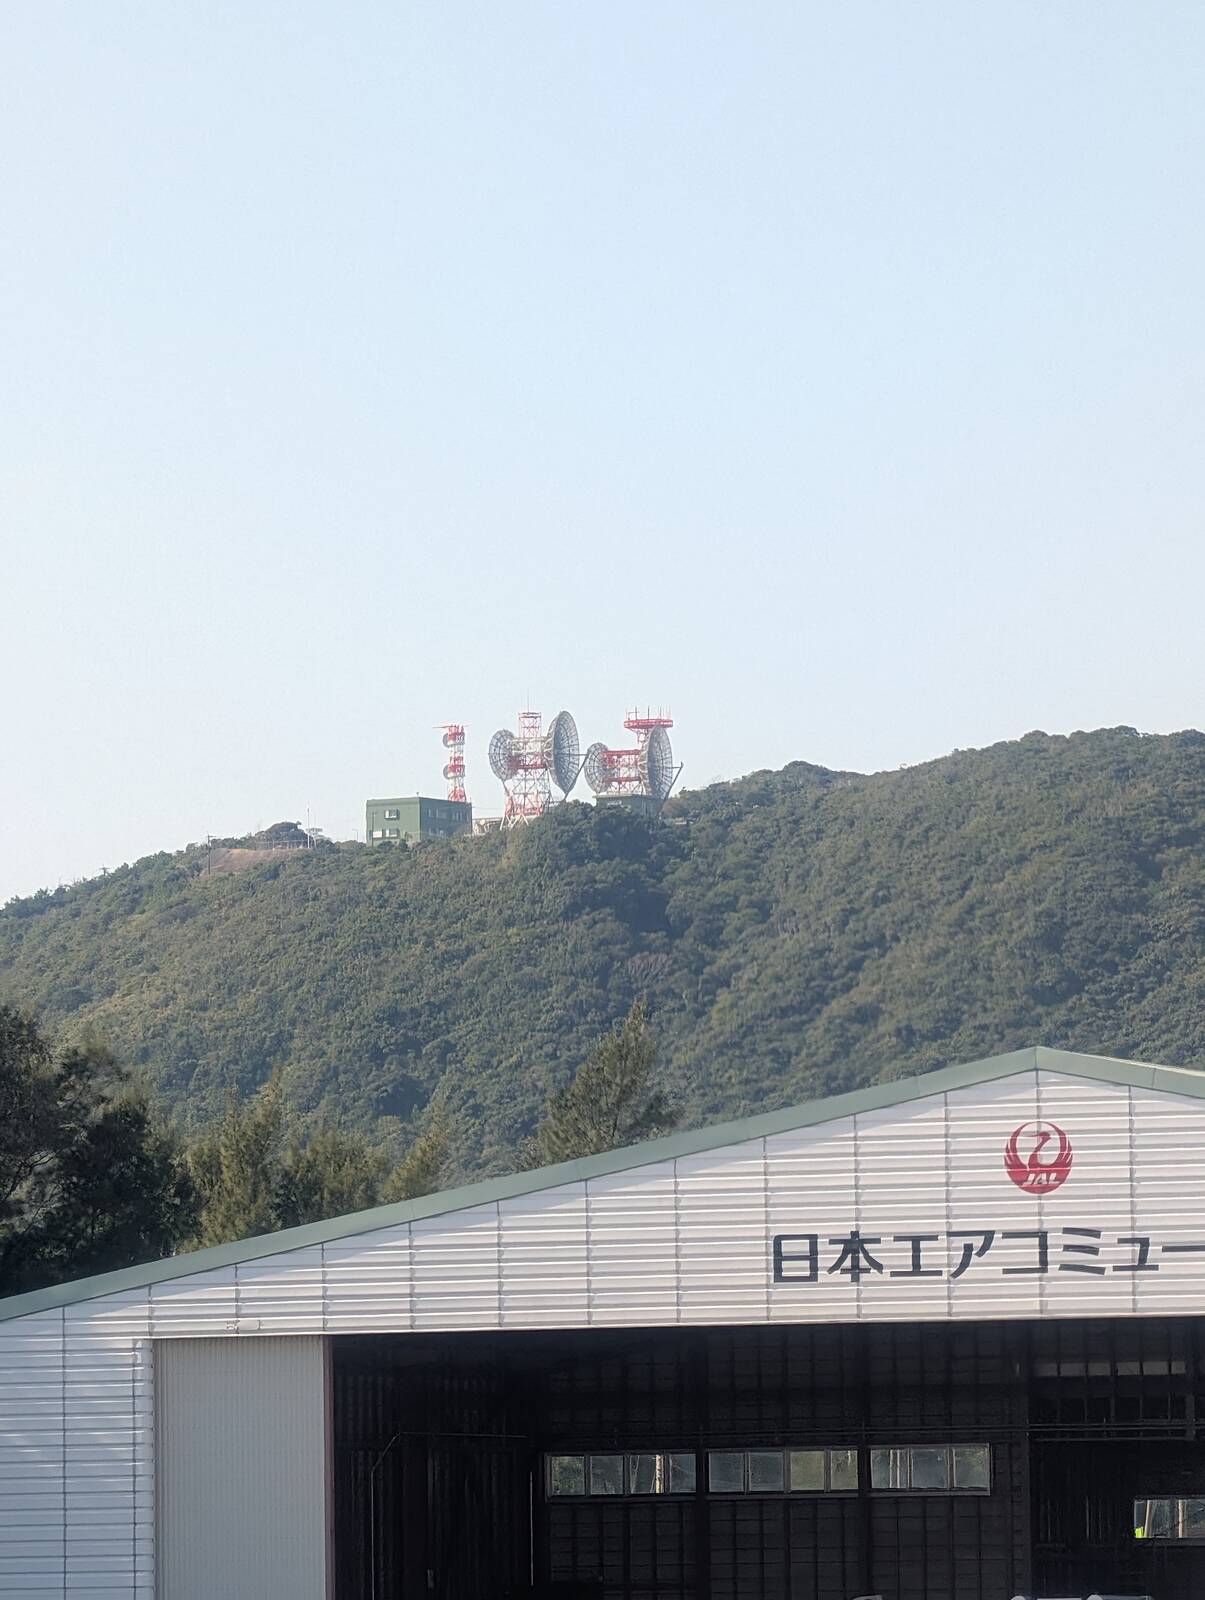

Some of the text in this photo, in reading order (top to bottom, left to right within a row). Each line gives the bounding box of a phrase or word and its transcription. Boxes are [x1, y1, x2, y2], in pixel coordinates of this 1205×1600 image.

[1021, 1172, 1062, 1187] JAL
[773, 1227, 1205, 1283] 日本エアコミュー
